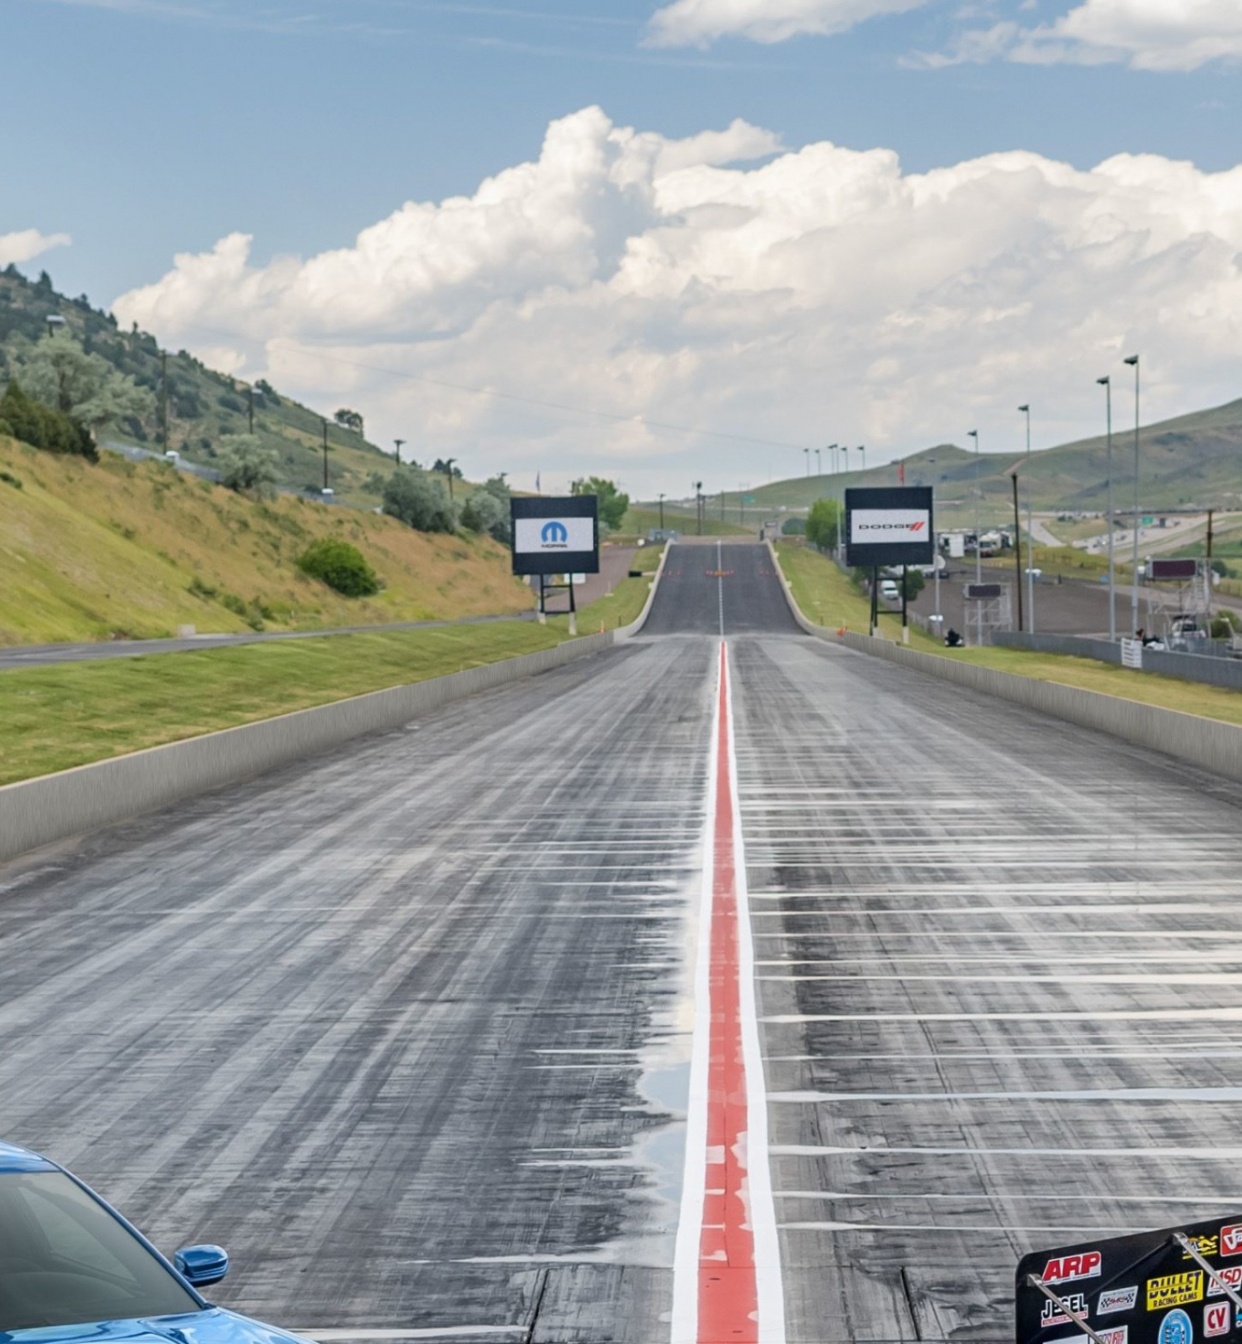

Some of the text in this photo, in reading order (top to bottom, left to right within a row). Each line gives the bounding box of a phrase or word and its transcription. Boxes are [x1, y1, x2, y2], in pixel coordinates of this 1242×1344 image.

[1042, 1253, 1100, 1281] ARP
[1149, 1271, 1201, 1299] BULLET
[1154, 1292, 1197, 1307] RACING CAMS
[1207, 1307, 1226, 1329] CV
